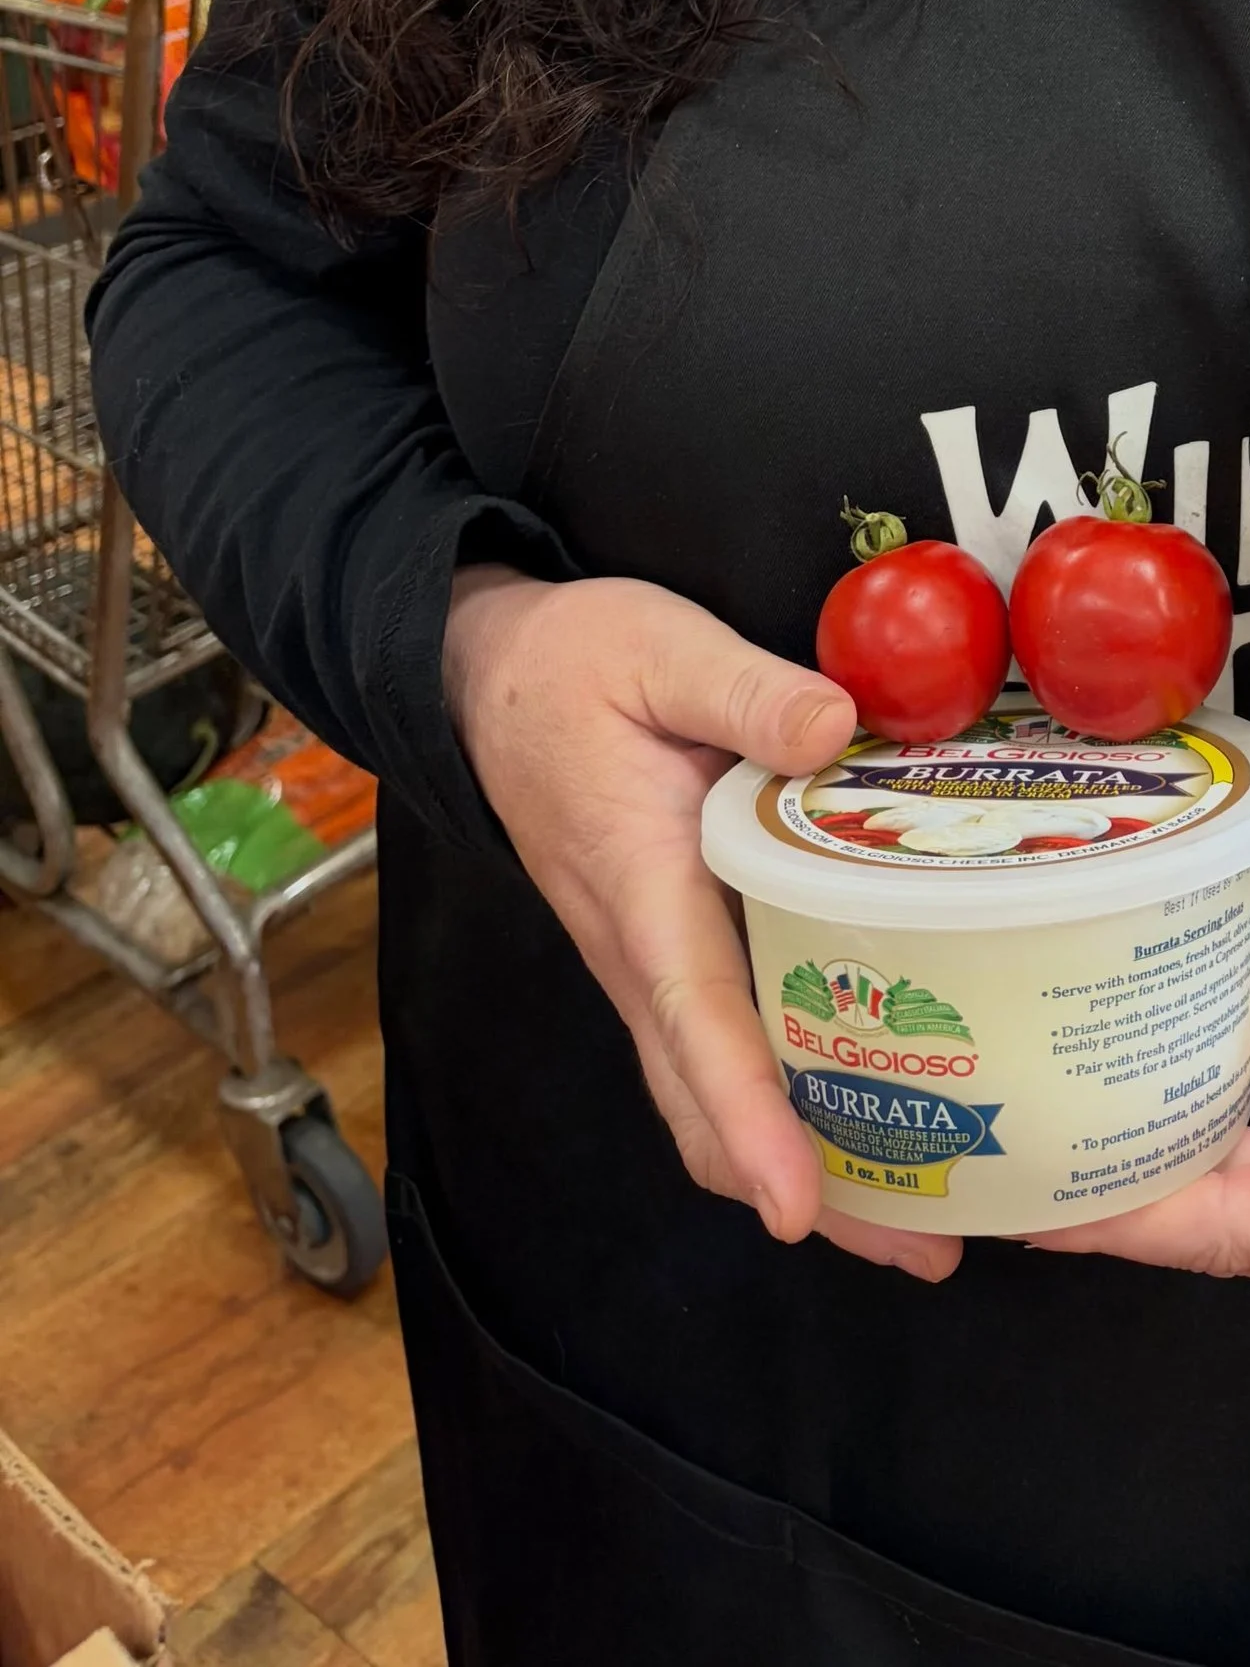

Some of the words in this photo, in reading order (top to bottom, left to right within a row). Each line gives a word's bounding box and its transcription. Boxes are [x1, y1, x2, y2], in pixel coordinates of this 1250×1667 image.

[901, 766, 1130, 785] BURRATA
[1090, 783, 1142, 791] FILLED
[840, 845, 934, 865] BELGIOIOSO
[939, 855, 1012, 865] CHEESE
[1149, 824, 1166, 836] WI
[1134, 936, 1180, 960] Burrata
[1183, 917, 1223, 943] Serving
[1224, 901, 1245, 923] Ideas
[1163, 897, 1186, 917] Best
[1052, 983, 1092, 999] Serve
[1094, 974, 1125, 991] with
[1128, 959, 1183, 984] tomatoes,
[1185, 944, 1210, 964] fresh
[1089, 989, 1137, 1013] pepper
[1138, 979, 1157, 996] for
[1158, 980, 1165, 991] a
[1167, 968, 1193, 988] twist
[1195, 962, 1207, 976] on
[1215, 938, 1244, 964] Caprese
[1052, 1036, 1100, 1056] freshly
[1102, 1025, 1149, 1049] ground
[1150, 1009, 1192, 1037] pepper.
[1193, 995, 1219, 1016] Serve
[1219, 988, 1230, 1001] on
[1062, 1020, 1111, 1038] Drizzle
[1114, 1009, 1143, 1028] with
[1144, 1002, 1172, 1022] olive
[1174, 993, 1188, 1011] oil
[1189, 983, 1207, 1003] and
[1209, 965, 1240, 994] sprinkle
[1076, 1061, 1103, 1077] Pair
[1106, 1052, 1134, 1071] with
[1136, 1042, 1166, 1061] fresh
[1167, 1025, 1201, 1054] grilled
[1202, 1002, 1241, 1034] vegetables
[1103, 1069, 1140, 1087] meats
[1142, 1059, 1160, 1076] for
[1160, 1058, 1168, 1069] a
[1169, 1046, 1194, 1065] tasty
[1195, 1024, 1232, 1053] antipasto
[804, 1073, 958, 1130] BURRATA
[1163, 1071, 1206, 1102] Helpful
[1207, 1063, 1221, 1081] Tip
[801, 1098, 824, 1118] FRESH
[824, 1109, 885, 1137] MOZZARELLA
[887, 1127, 929, 1142] CHEESE
[931, 1131, 970, 1144] FILLED
[810, 1114, 832, 1132] WITH
[831, 1122, 867, 1143] SHREDS
[868, 1134, 882, 1145] OF
[883, 1137, 958, 1154] MOZZARELLA
[1081, 1137, 1098, 1151] To
[1101, 1125, 1145, 1152] portion
[1147, 1108, 1189, 1133] Burrata,
[1190, 1099, 1205, 1114] the
[1206, 1084, 1222, 1105] best
[1223, 1072, 1235, 1093] tool
[833, 1134, 869, 1154] SOAKED
[871, 1145, 885, 1157] IN
[886, 1150, 924, 1163] CREAM
[1053, 1186, 1088, 1202] Once
[1091, 1170, 1140, 1197] opened,
[1142, 1165, 1161, 1180] use
[1163, 1148, 1197, 1170] within
[1198, 1136, 1211, 1154] 1-2
[1211, 1125, 1228, 1145] days
[1071, 1163, 1118, 1184] Burrata
[1121, 1159, 1132, 1172] is
[1135, 1146, 1165, 1168] made
[1167, 1134, 1190, 1154] with
[1192, 1126, 1206, 1142] the
[1207, 1108, 1229, 1133] finest
[844, 1160, 854, 1175] 8
[857, 1168, 880, 1182] oz.
[883, 1169, 920, 1189] Ball
